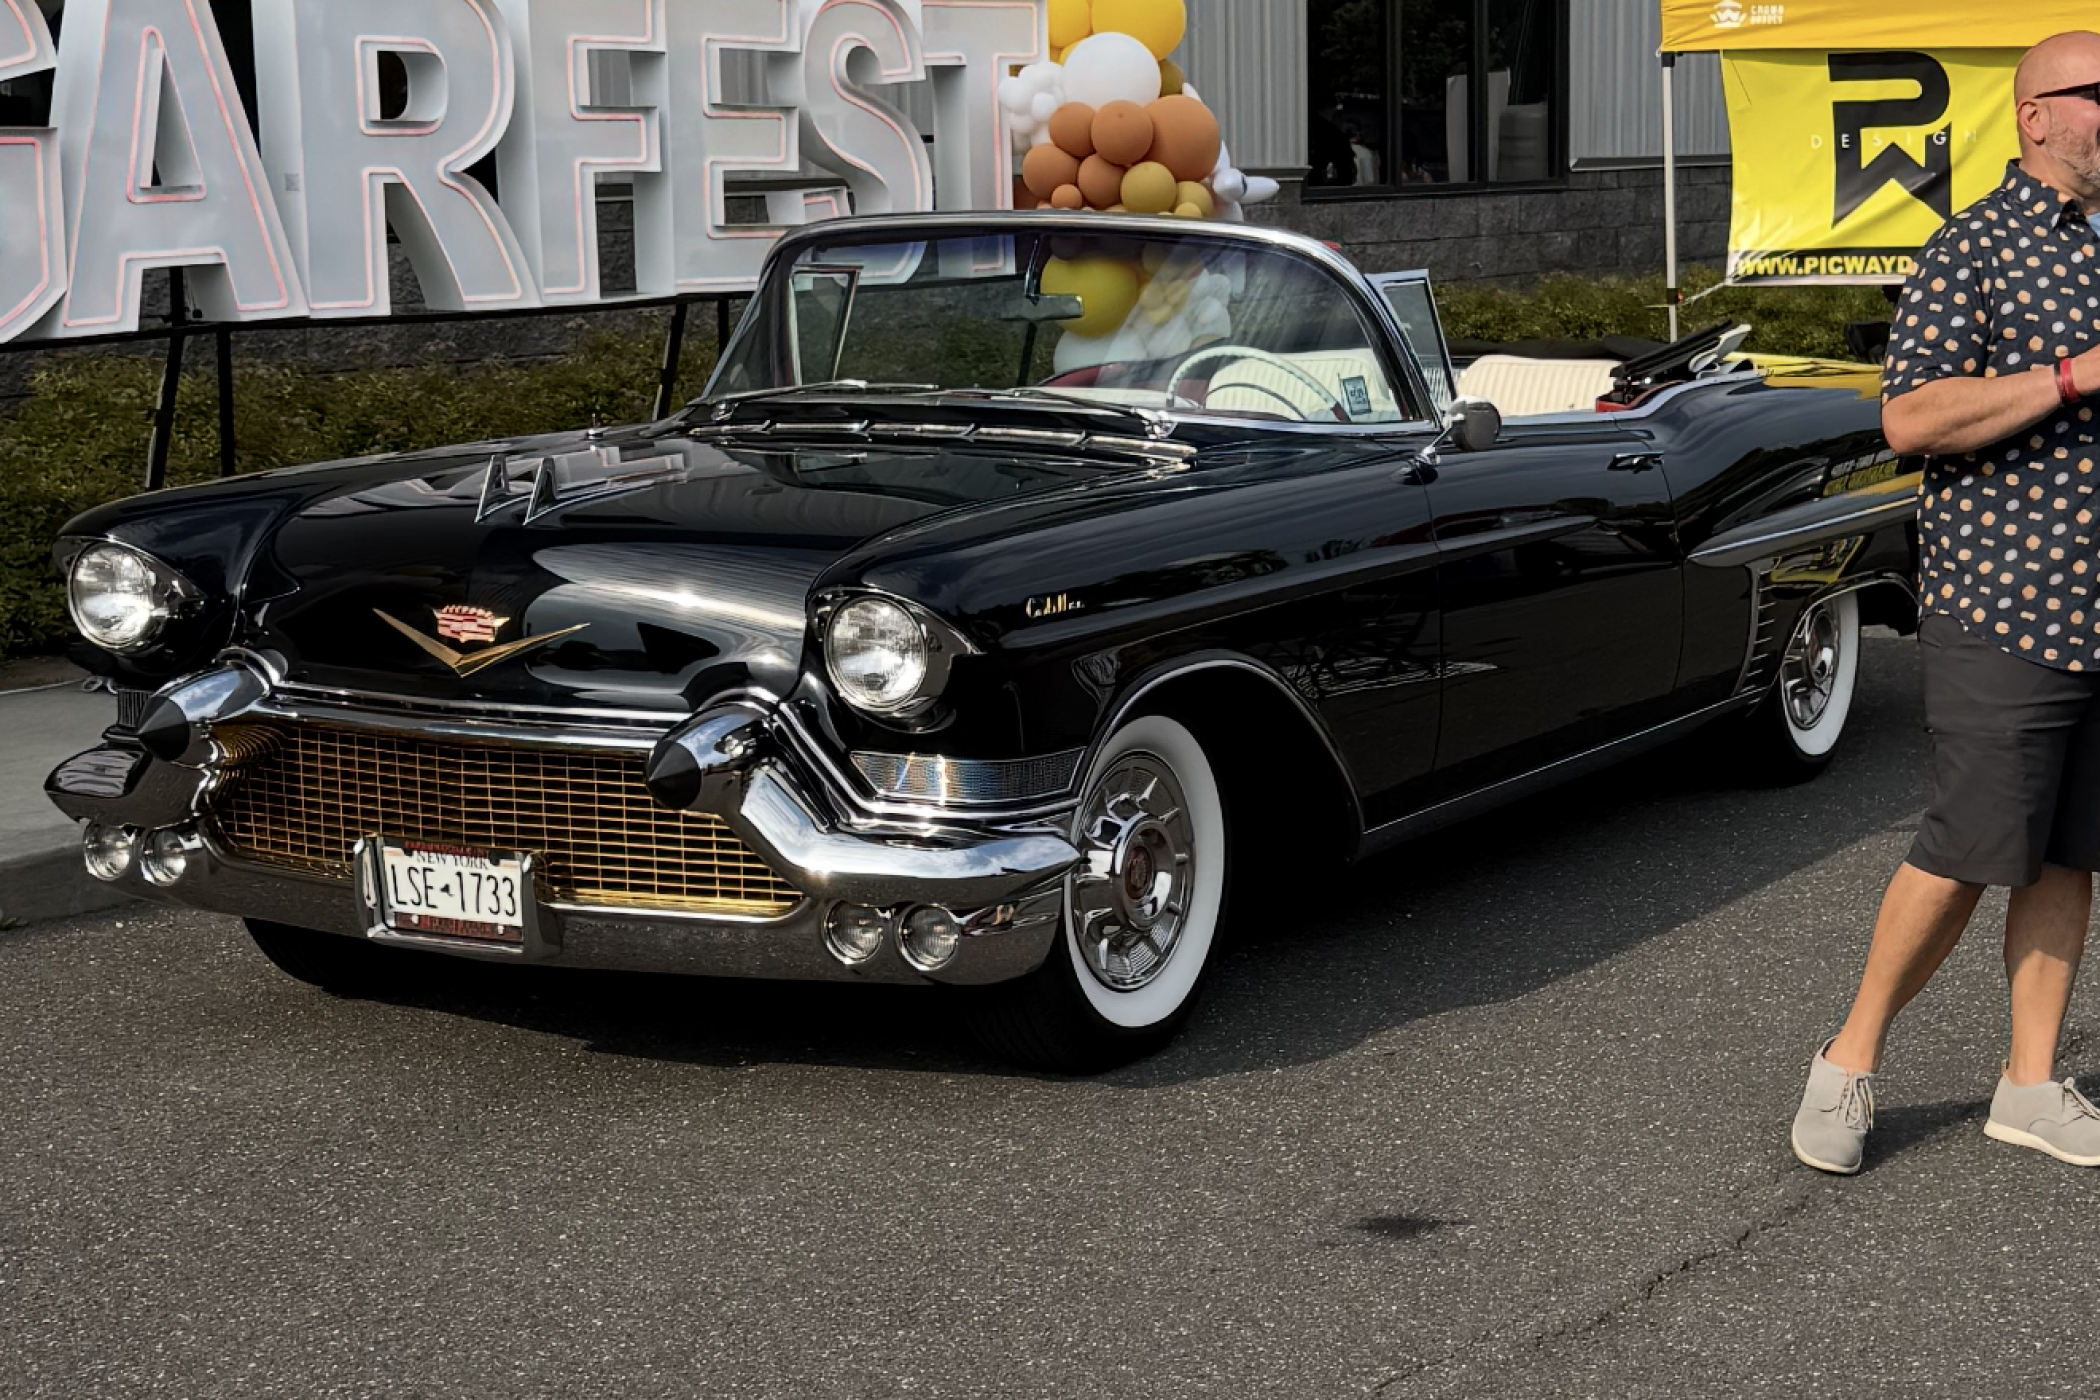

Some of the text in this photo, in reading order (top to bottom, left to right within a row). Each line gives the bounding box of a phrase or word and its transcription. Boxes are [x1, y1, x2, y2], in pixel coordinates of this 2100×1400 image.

[1811, 131, 1977, 149] DESIGN
[417, 852, 489, 870] NEW YORK
[392, 864, 516, 917] LSE 1733
